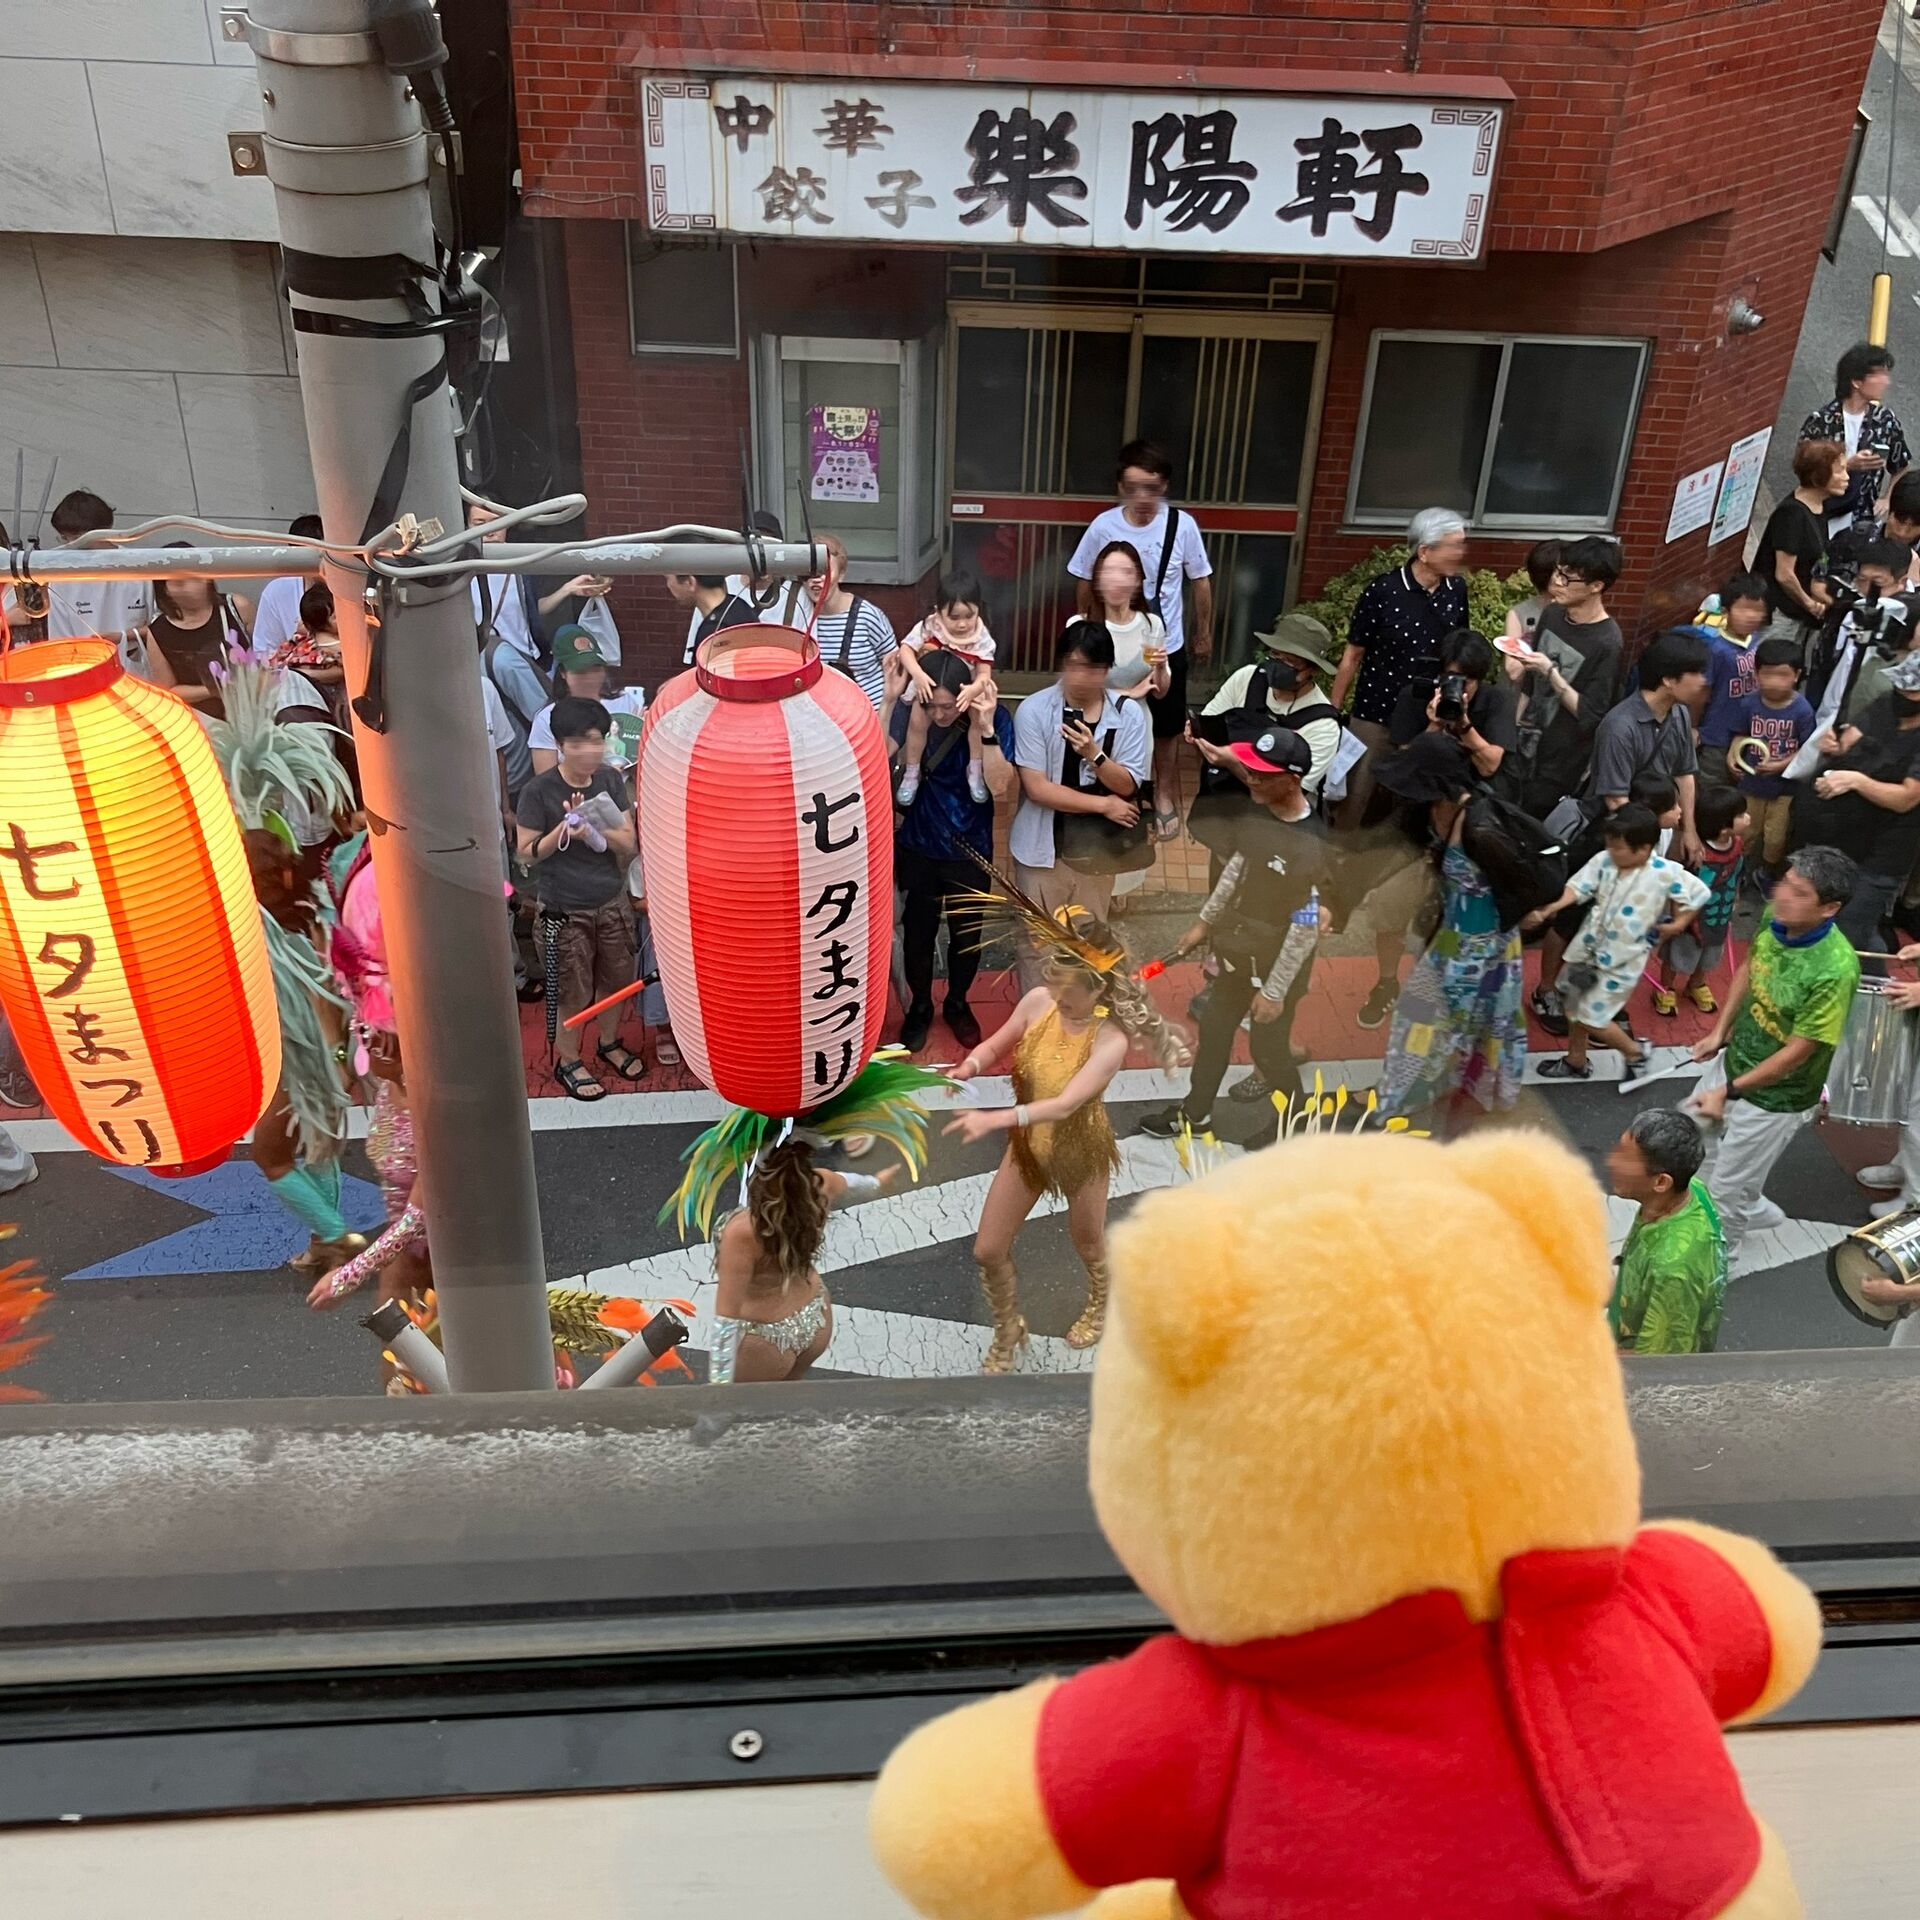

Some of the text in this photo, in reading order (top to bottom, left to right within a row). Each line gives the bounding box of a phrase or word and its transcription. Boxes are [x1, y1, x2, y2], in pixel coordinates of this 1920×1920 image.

[714, 95, 894, 158] 中華
[753, 166, 935, 228] 餃子
[0, 821, 162, 1165] 七夕まつり
[802, 791, 862, 1103] 七夕まつり
